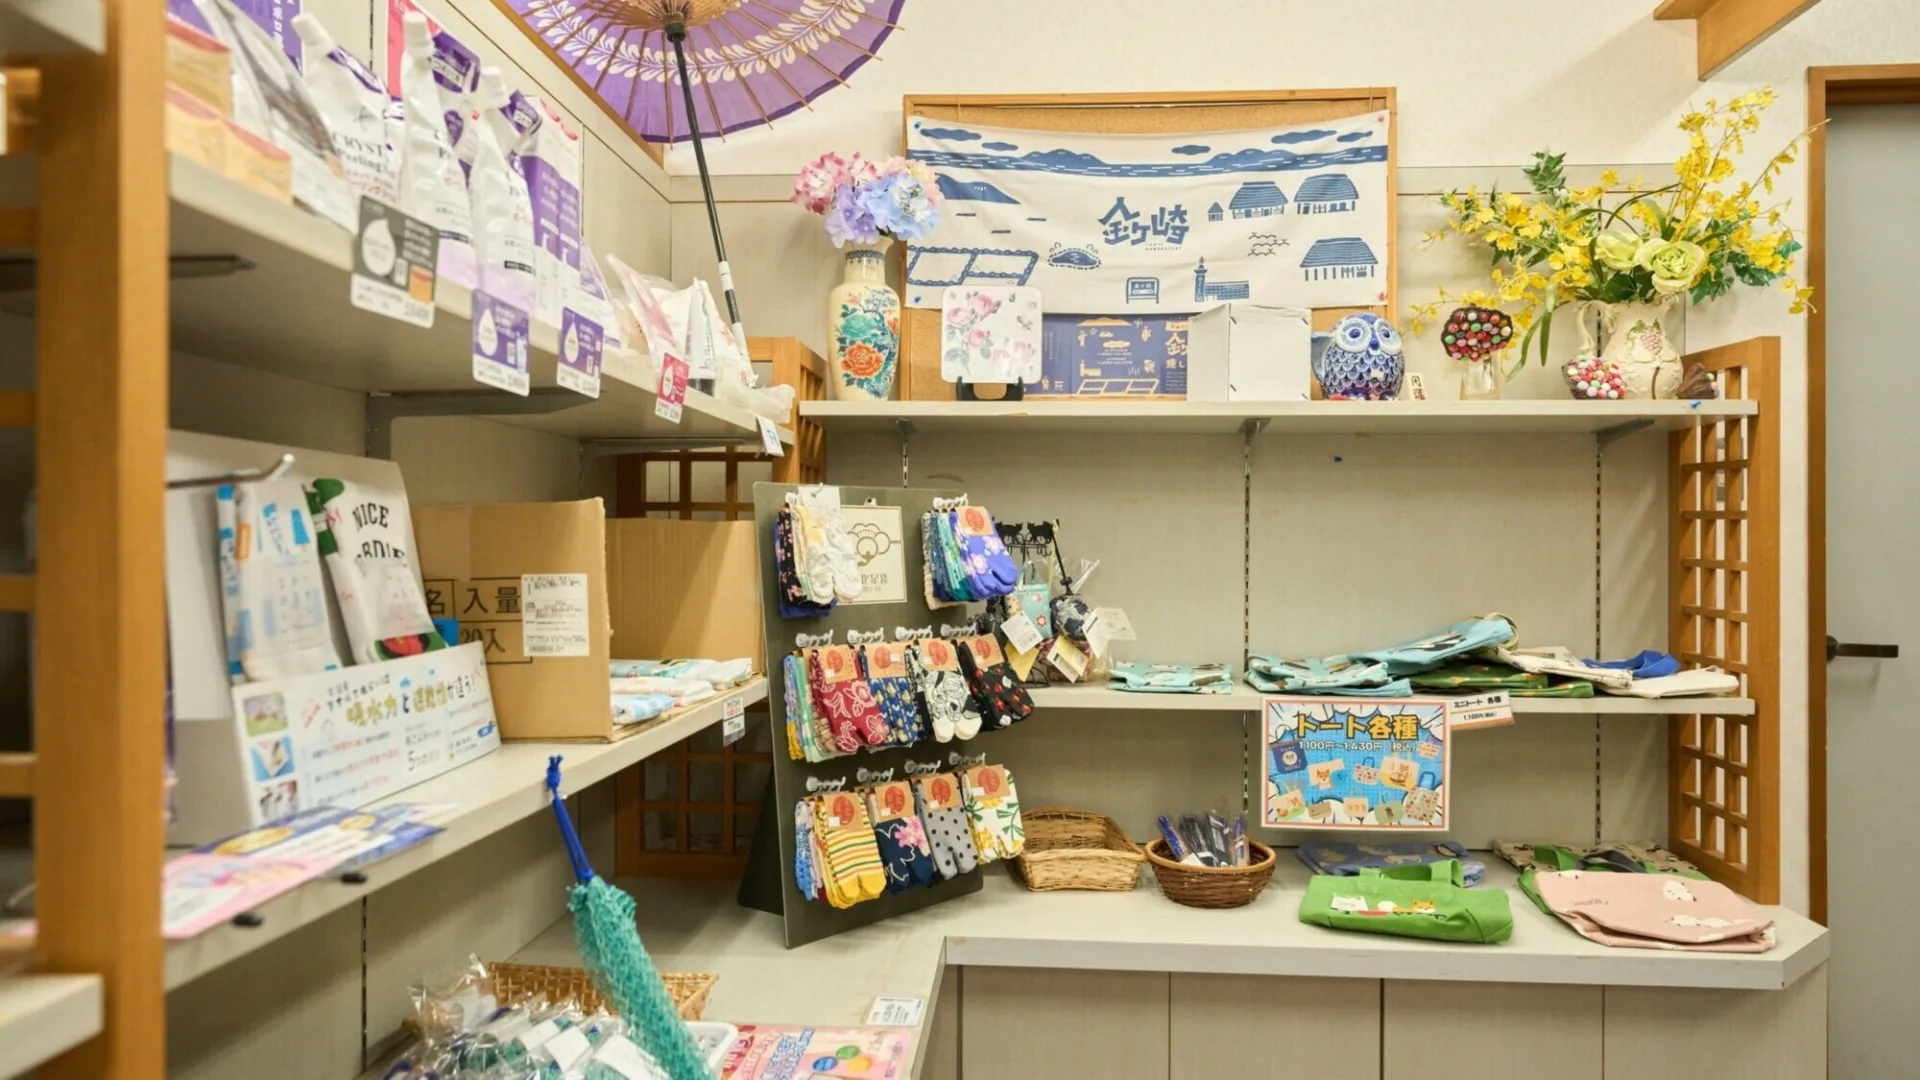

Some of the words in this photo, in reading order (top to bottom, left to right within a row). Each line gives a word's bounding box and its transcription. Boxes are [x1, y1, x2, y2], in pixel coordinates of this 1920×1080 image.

[352, 502, 389, 531] NICE
[1296, 712, 1420, 741] トート各種
